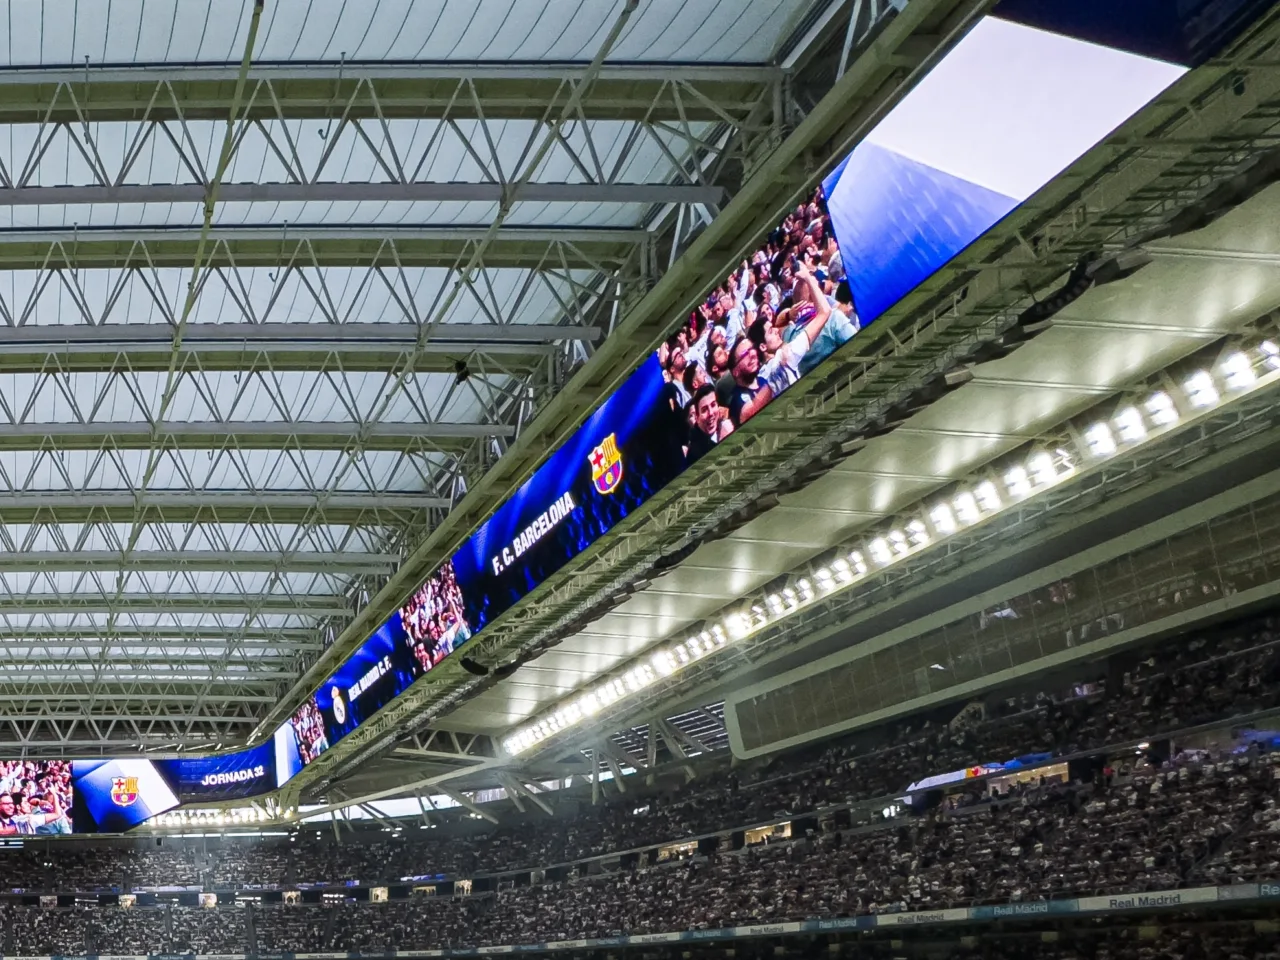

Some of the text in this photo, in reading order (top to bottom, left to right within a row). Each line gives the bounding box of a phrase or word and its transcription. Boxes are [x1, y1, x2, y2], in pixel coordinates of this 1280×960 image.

[492, 491, 575, 576] F. C. BARCELONA
[201, 764, 265, 786] JORNADA 32
[1260, 883, 1280, 896] Re
[1109, 894, 1181, 908] Real Madrid
[993, 903, 1048, 915] Real Madrid
